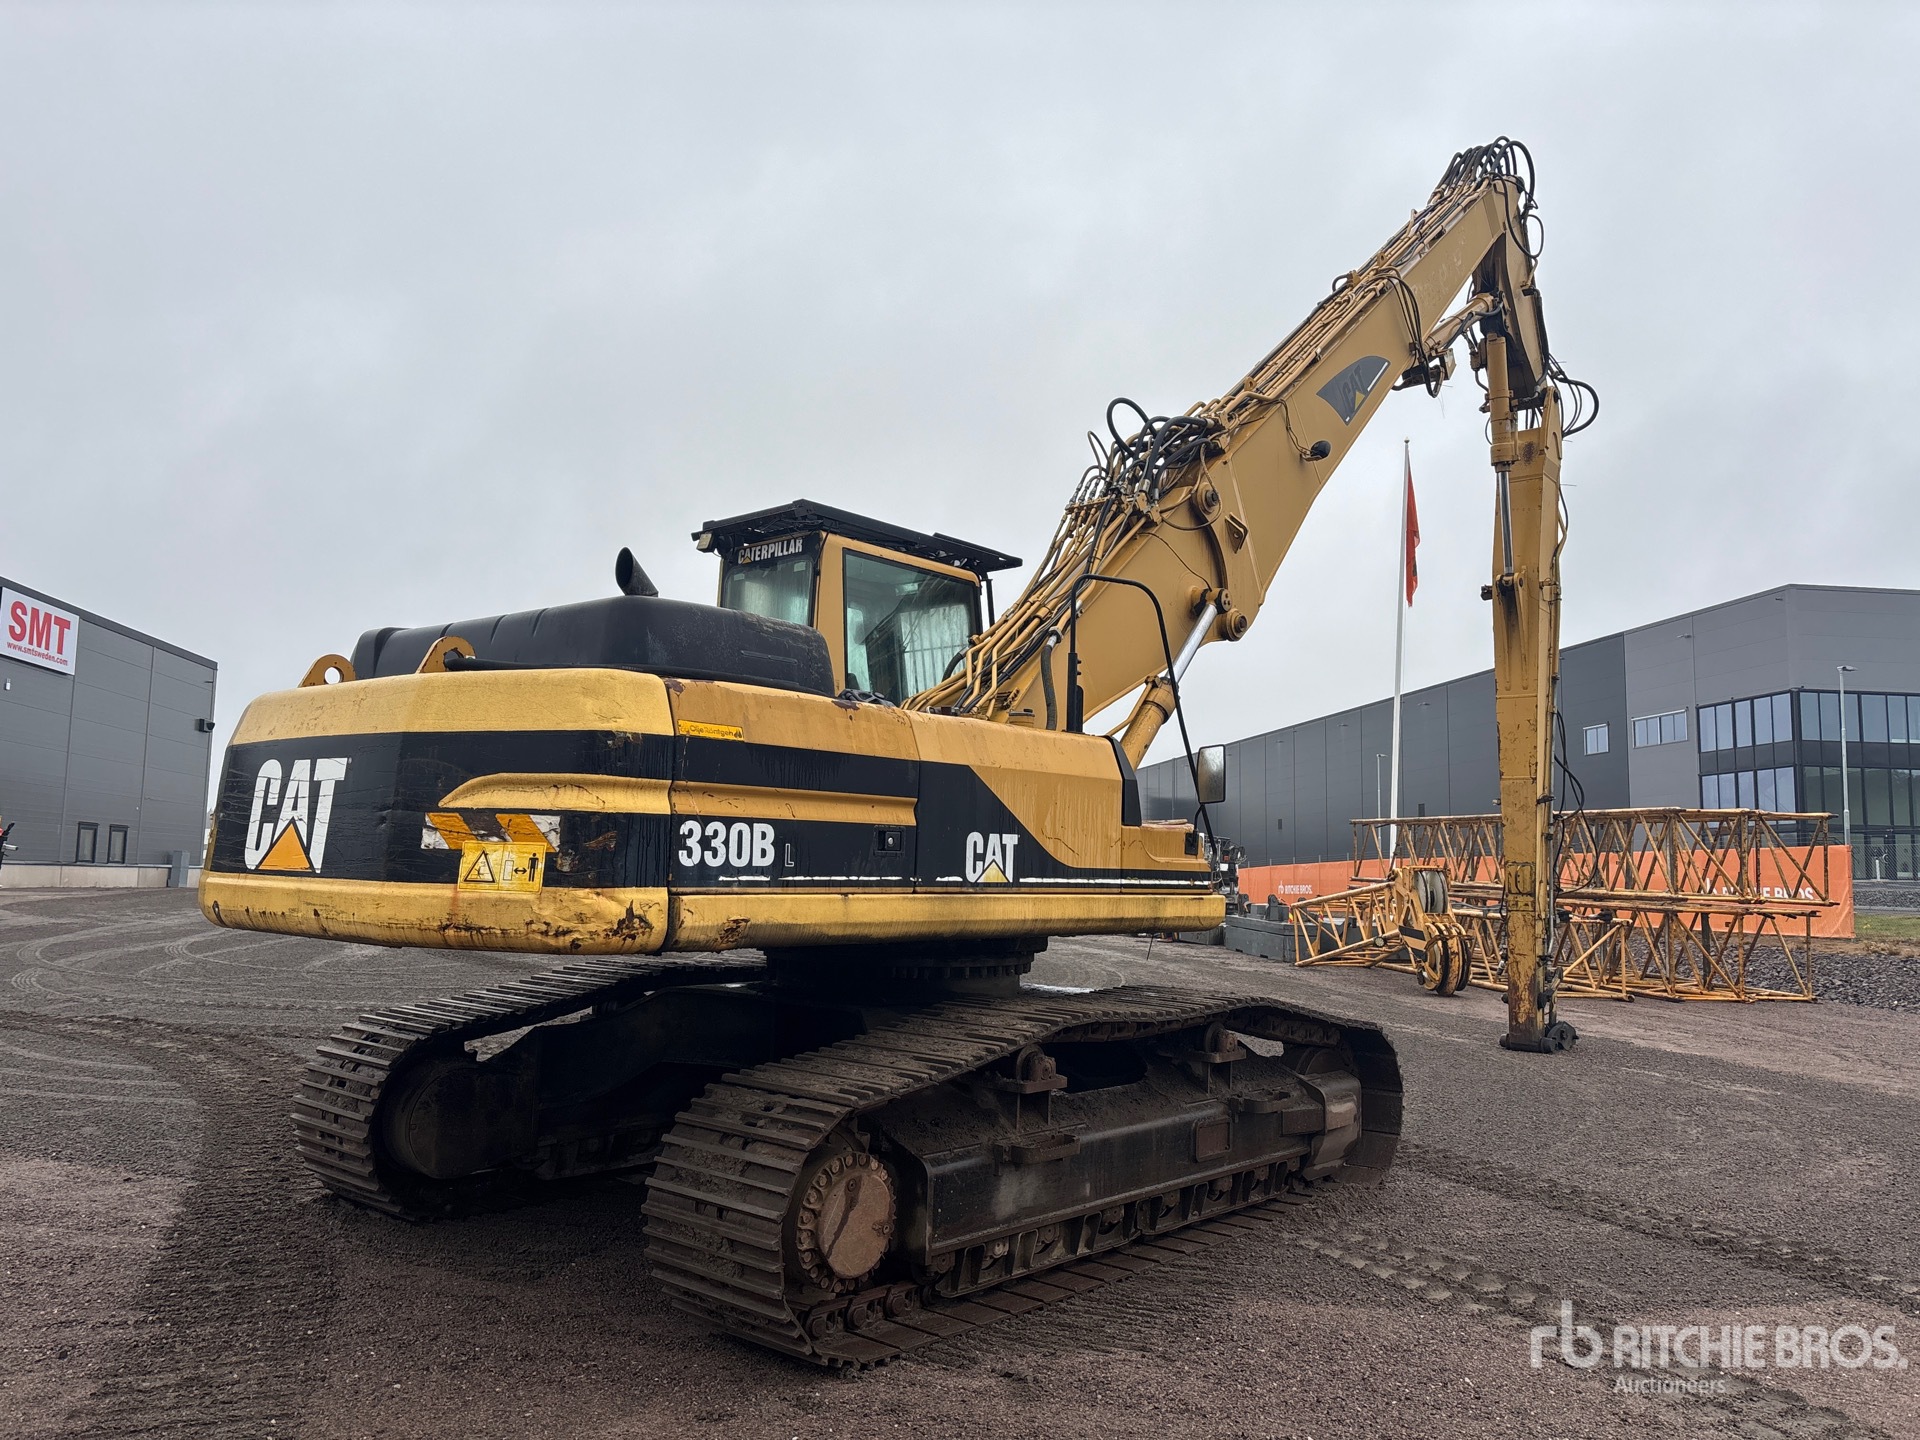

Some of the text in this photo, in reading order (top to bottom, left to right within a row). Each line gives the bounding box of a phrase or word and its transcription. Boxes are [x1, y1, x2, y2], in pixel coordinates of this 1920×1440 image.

[738, 538, 803, 564] CATERPILLAR
[8, 600, 71, 655] SMT
[7, 641, 68, 666] www.smtsweden.com
[245, 758, 348, 874] CAT
[678, 820, 795, 867] 330B L
[965, 831, 1019, 883] CAT
